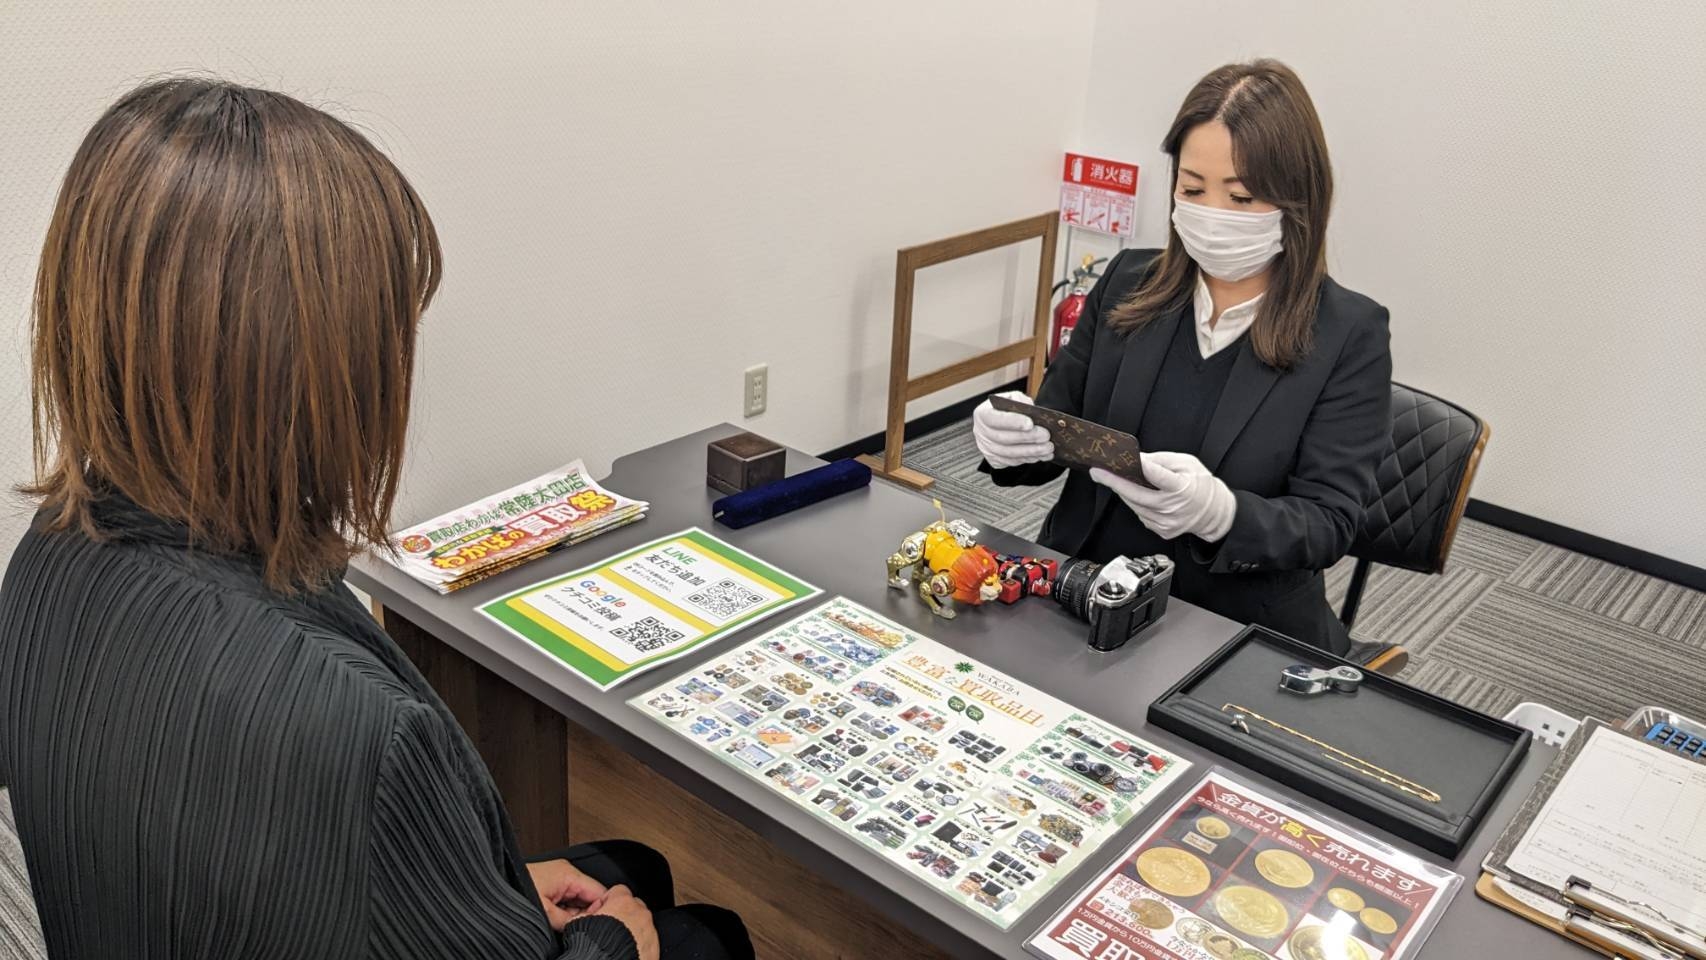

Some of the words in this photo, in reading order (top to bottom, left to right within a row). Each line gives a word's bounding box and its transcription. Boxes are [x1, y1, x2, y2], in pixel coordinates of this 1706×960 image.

[1090, 162, 1133, 186] 消火器
[432, 489, 616, 569] わかばの買取祭
[645, 554, 706, 586] 友だち追加
[662, 547, 697, 565] LINE
[580, 580, 627, 607] Google
[1218, 792, 1421, 891] 金貨が高く売れます
